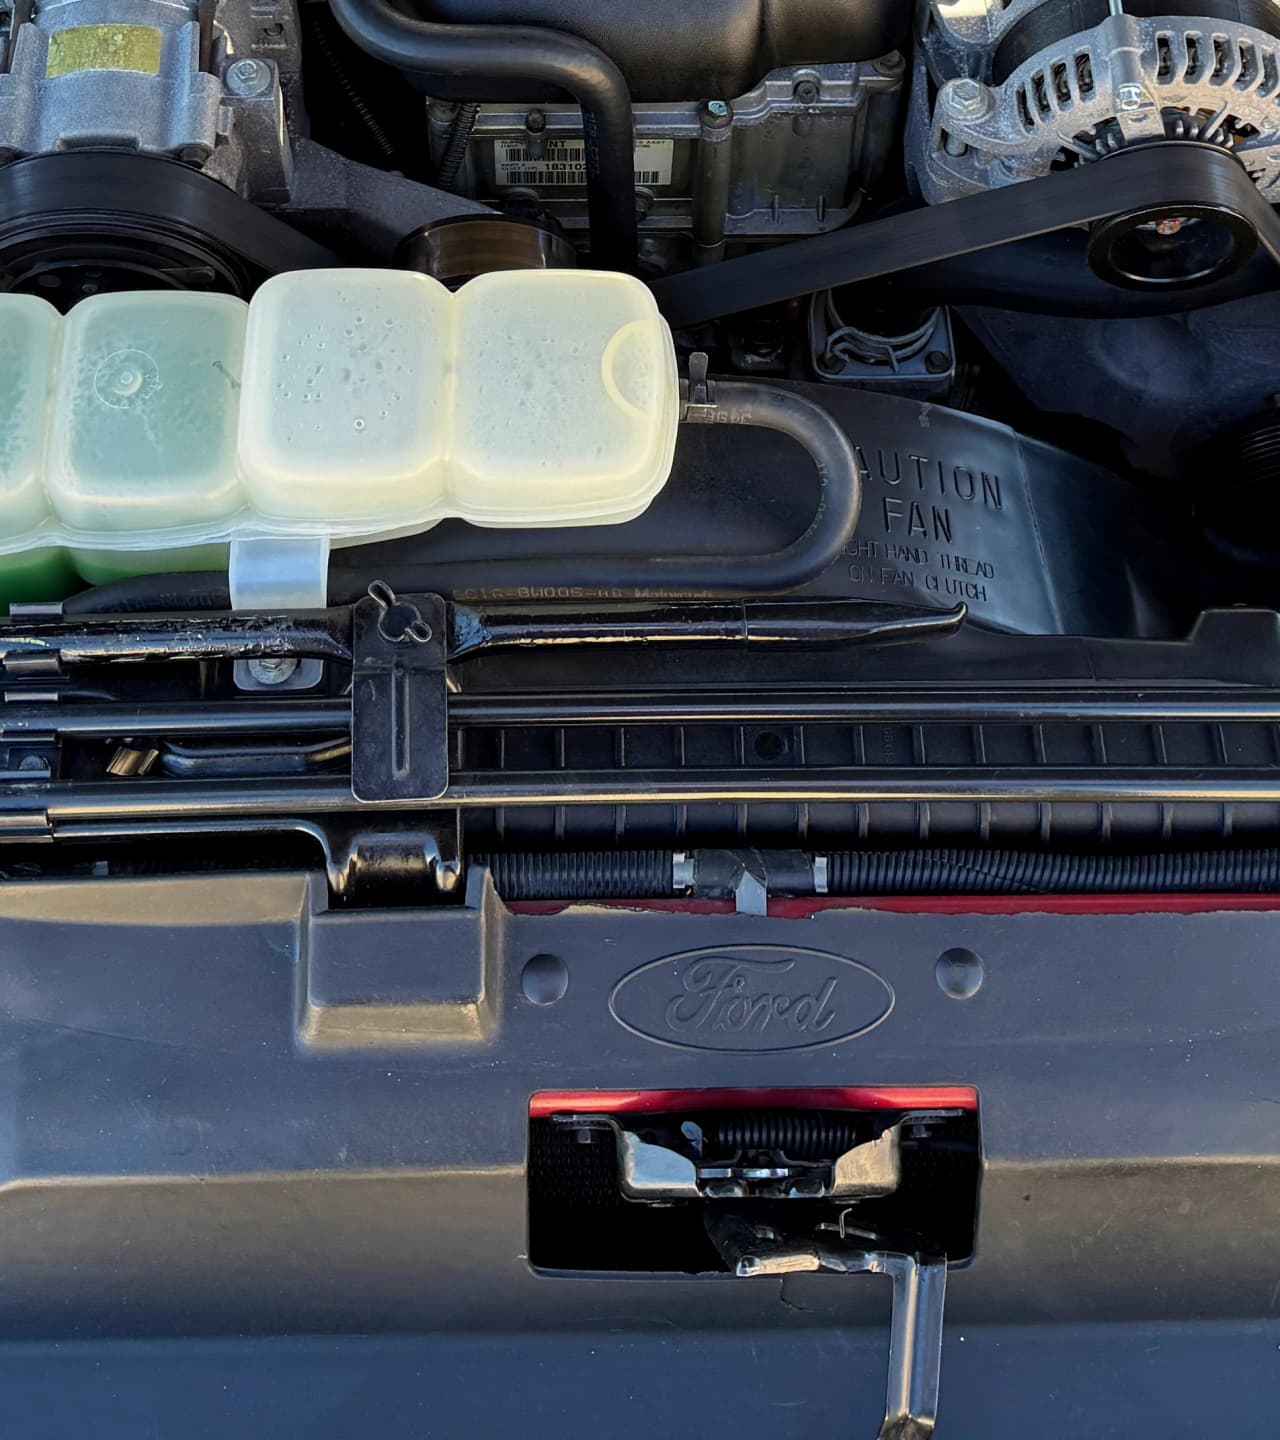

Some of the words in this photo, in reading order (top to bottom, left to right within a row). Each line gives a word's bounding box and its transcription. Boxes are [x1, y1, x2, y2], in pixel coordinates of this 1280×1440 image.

[855, 446, 1003, 511] AUTION
[882, 496, 954, 544] FAN
[848, 565, 872, 584] ON
[879, 567, 915, 588] FAN
[925, 575, 988, 603] CLUTCH
[884, 543, 928, 566] HAND
[939, 552, 995, 580] THREAD
[664, 954, 839, 1034] Ford
